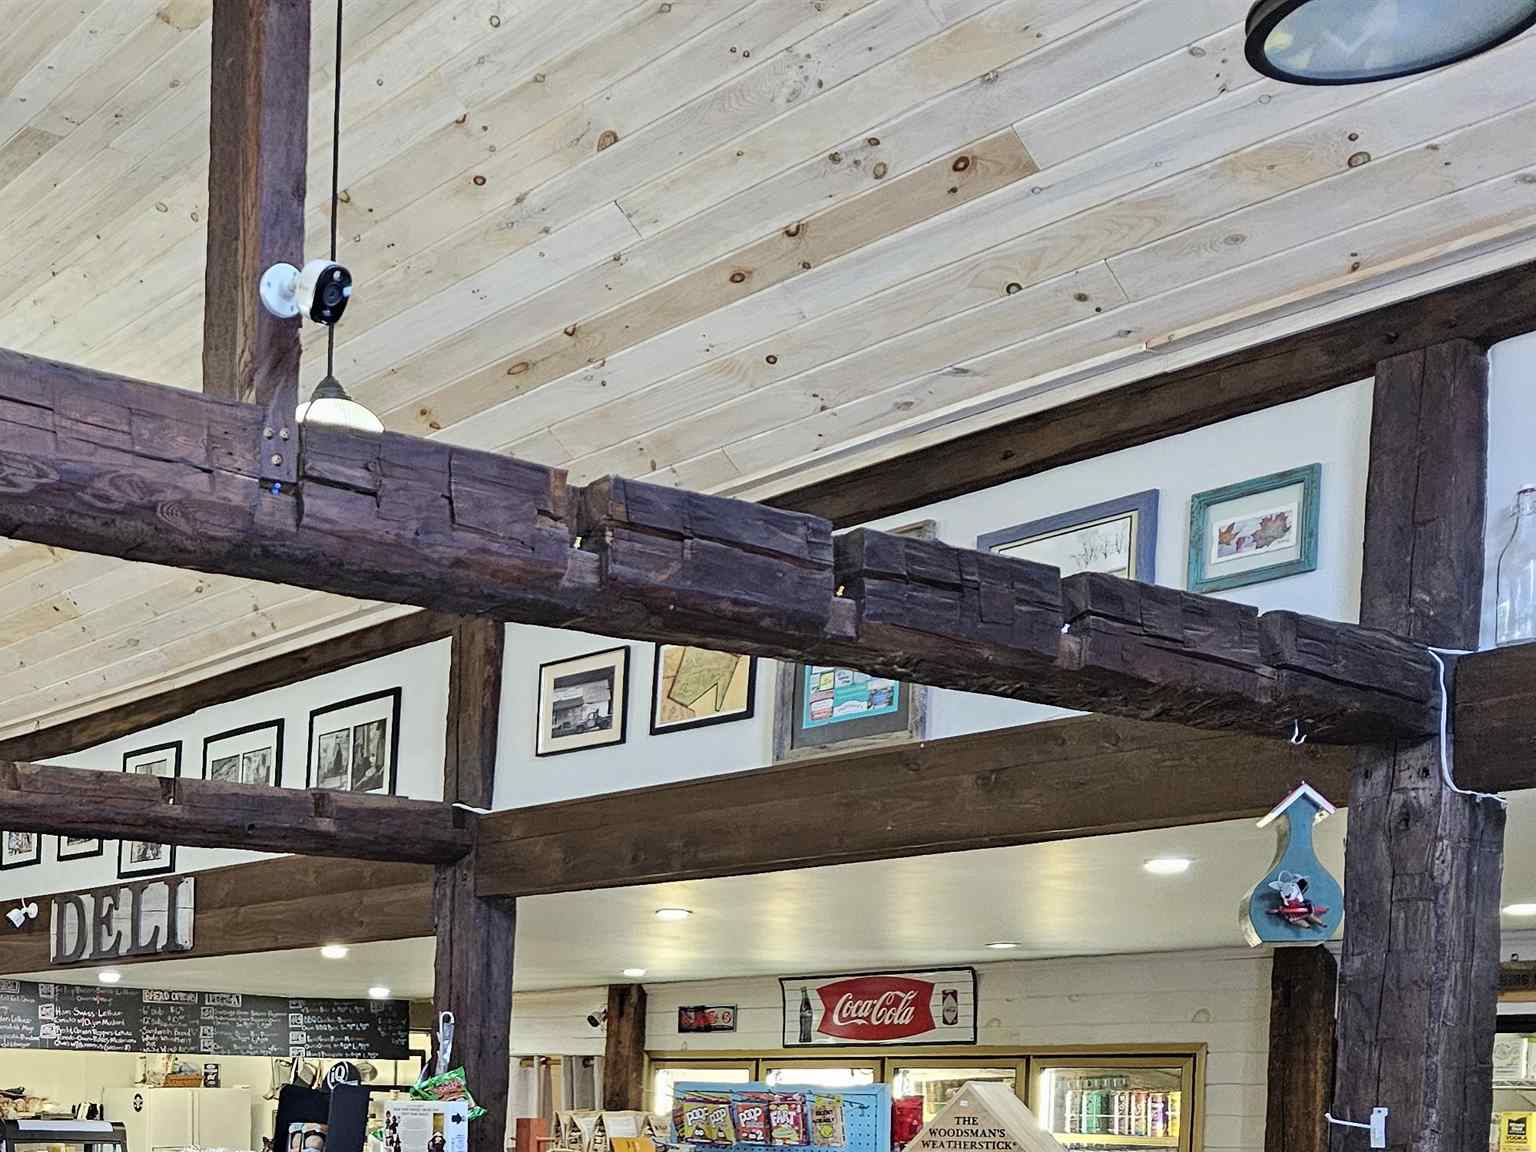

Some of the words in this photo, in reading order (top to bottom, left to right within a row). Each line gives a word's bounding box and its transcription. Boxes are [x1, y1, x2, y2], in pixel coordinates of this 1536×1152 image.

[51, 876, 185, 964] DELI
[832, 990, 919, 1026] Coca-Cola
[770, 1110, 798, 1125] FART
[953, 1116, 979, 1126] THE
[928, 1128, 1006, 1138] WOODSMAN'S
